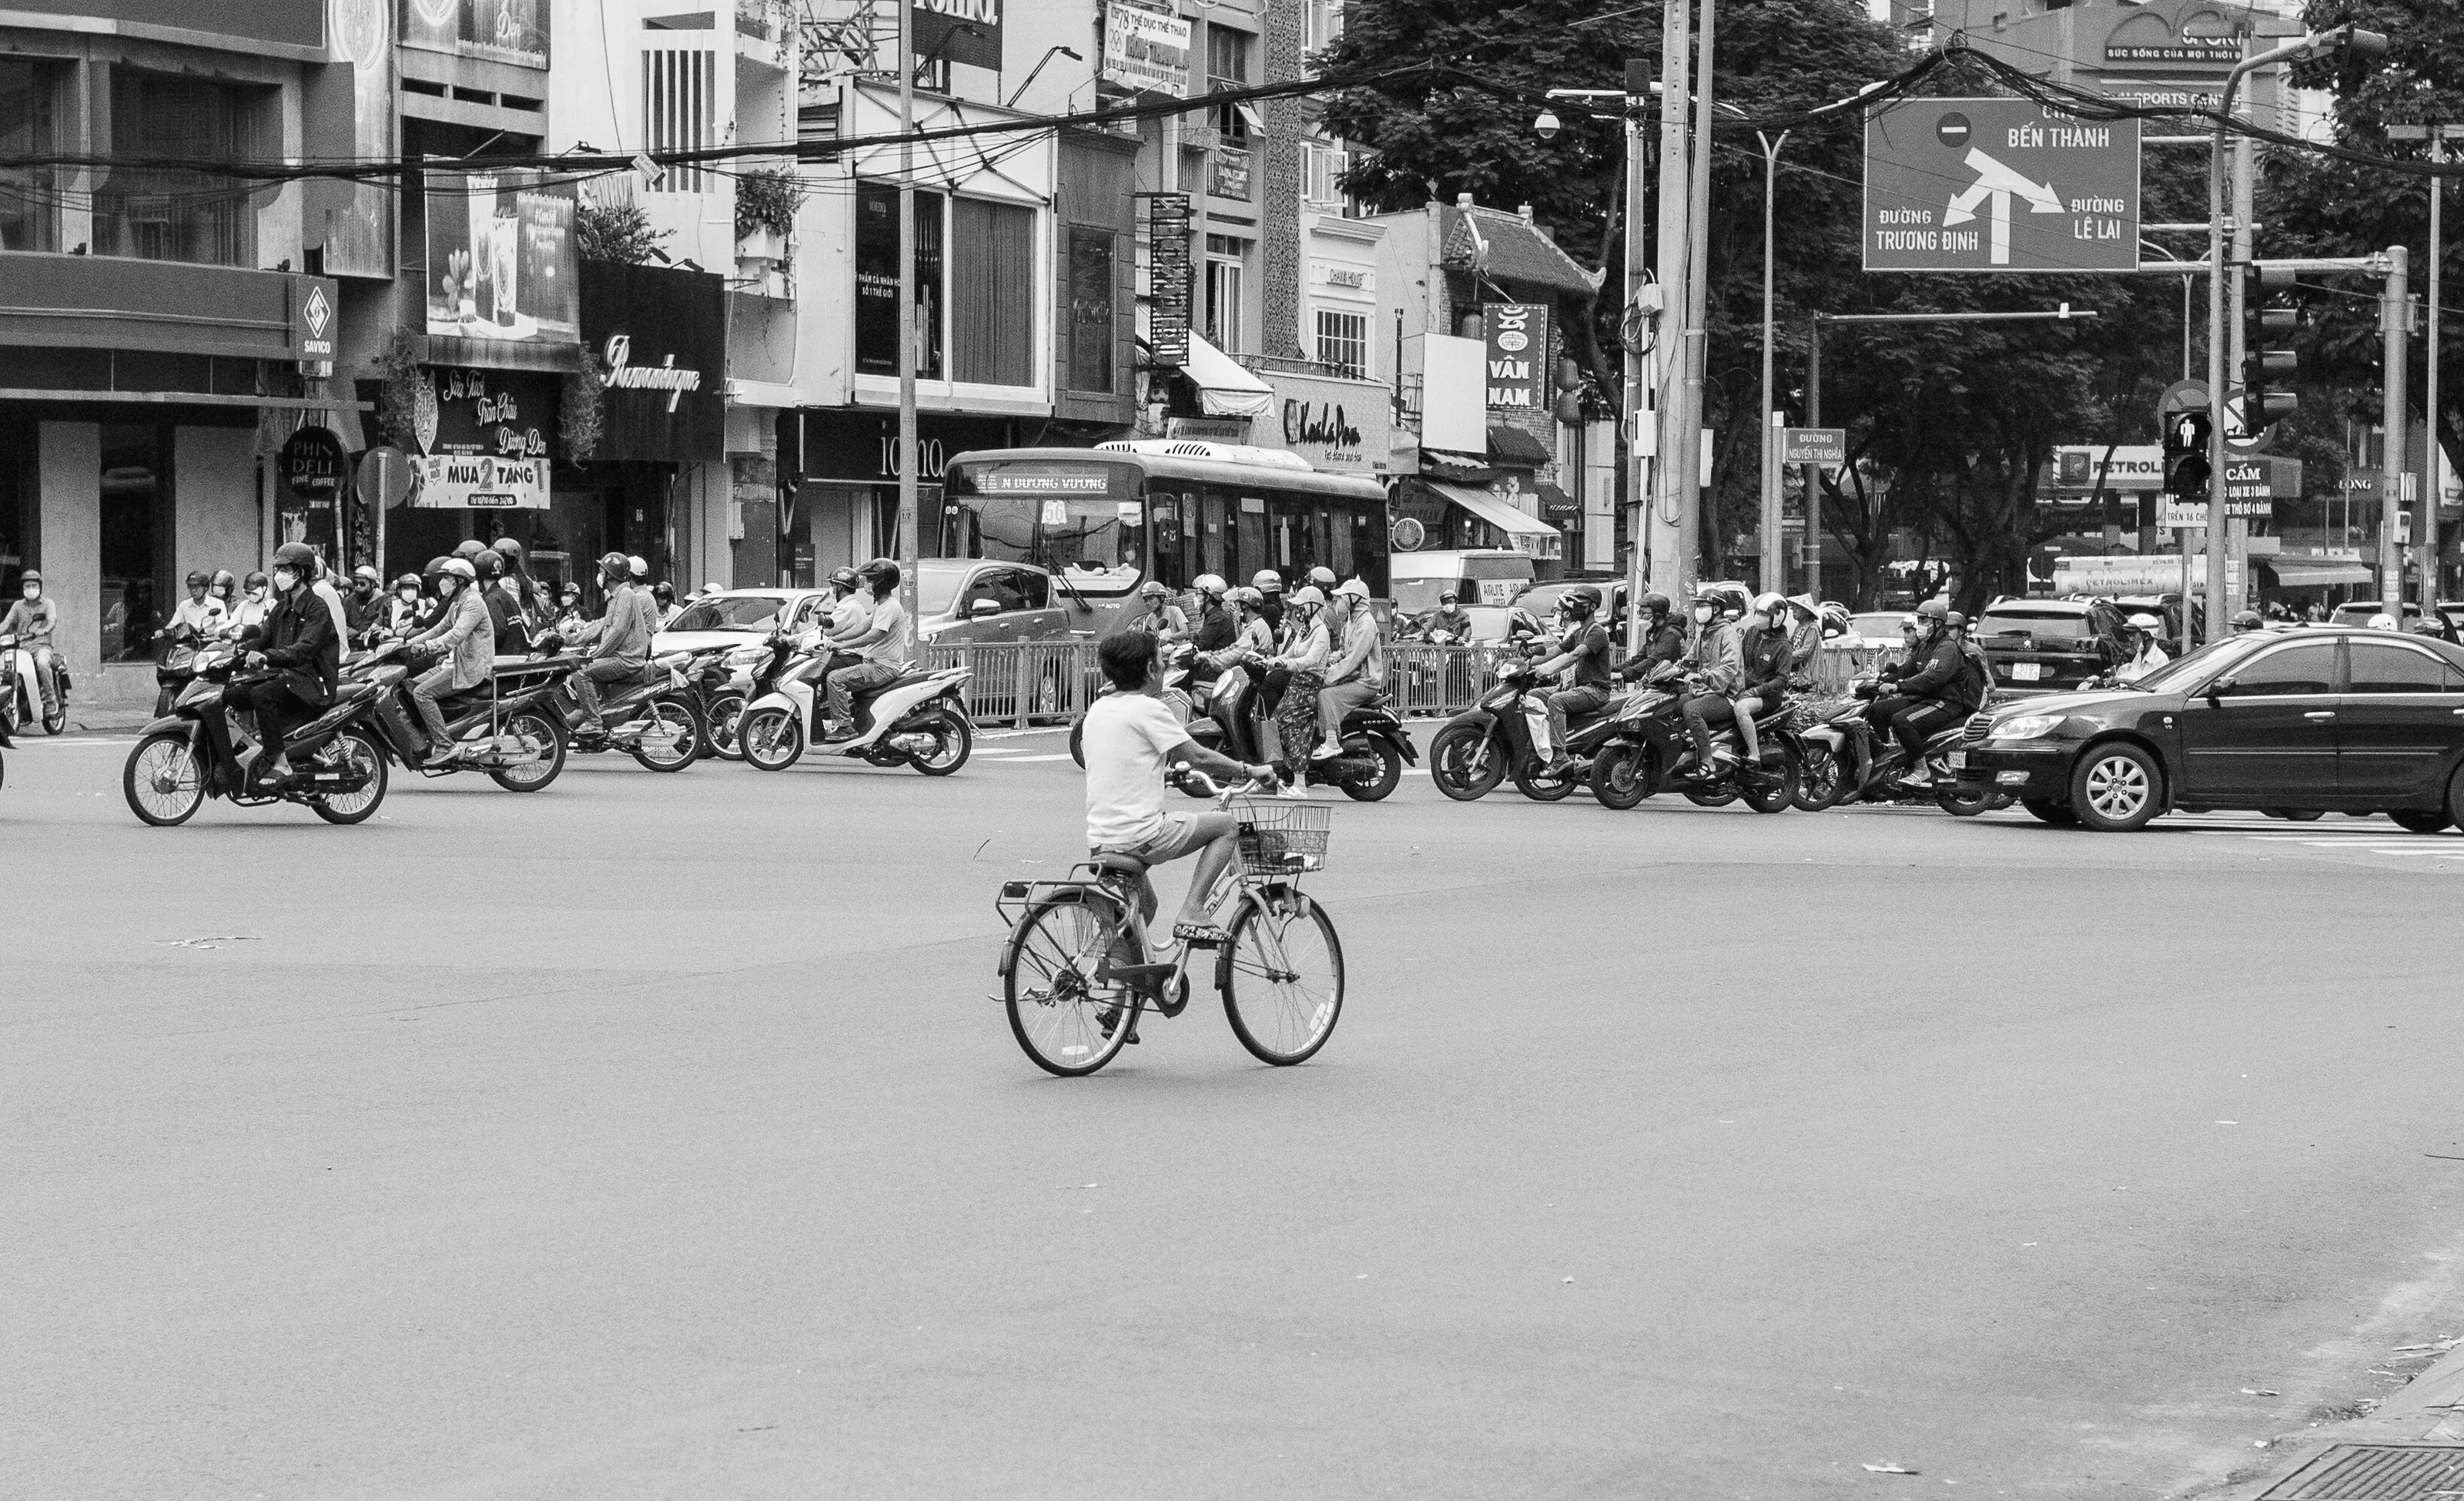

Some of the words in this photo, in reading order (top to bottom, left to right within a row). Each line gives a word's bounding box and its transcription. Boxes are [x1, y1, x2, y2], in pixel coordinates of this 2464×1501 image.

[1170, 24, 1187, 38] THAO
[2008, 121, 2044, 148] BẾN
[2049, 122, 2110, 148] THÀNH
[2071, 195, 2124, 213] ĐƯỜNG
[1879, 206, 1932, 224] ĐƯỜNG
[2074, 217, 2093, 240] LÊ
[2097, 219, 2121, 240] LAI
[1876, 229, 1937, 251] TRƯƠNG
[1942, 230, 1979, 254] ĐỊNH
[304, 340, 331, 354] SAVICO
[1488, 354, 1531, 379] VÂN
[1488, 387, 1532, 406] NAM
[1799, 432, 1833, 443] ĐƯỜNG
[1789, 445, 1813, 460] NGUYỄN
[447, 465, 480, 484] MUA
[478, 457, 494, 492] 2
[534, 460, 544, 493] 1
[2225, 462, 2261, 481] CẤM
[2228, 485, 2242, 501] LOẠI
[2242, 485, 2250, 498] XE
[2255, 483, 2271, 498] BÁNH
[1045, 502, 1064, 521] 56
[2168, 511, 2184, 521] TRÊN
[2186, 512, 2194, 521] 16
[2256, 501, 2272, 515] BÁNH
